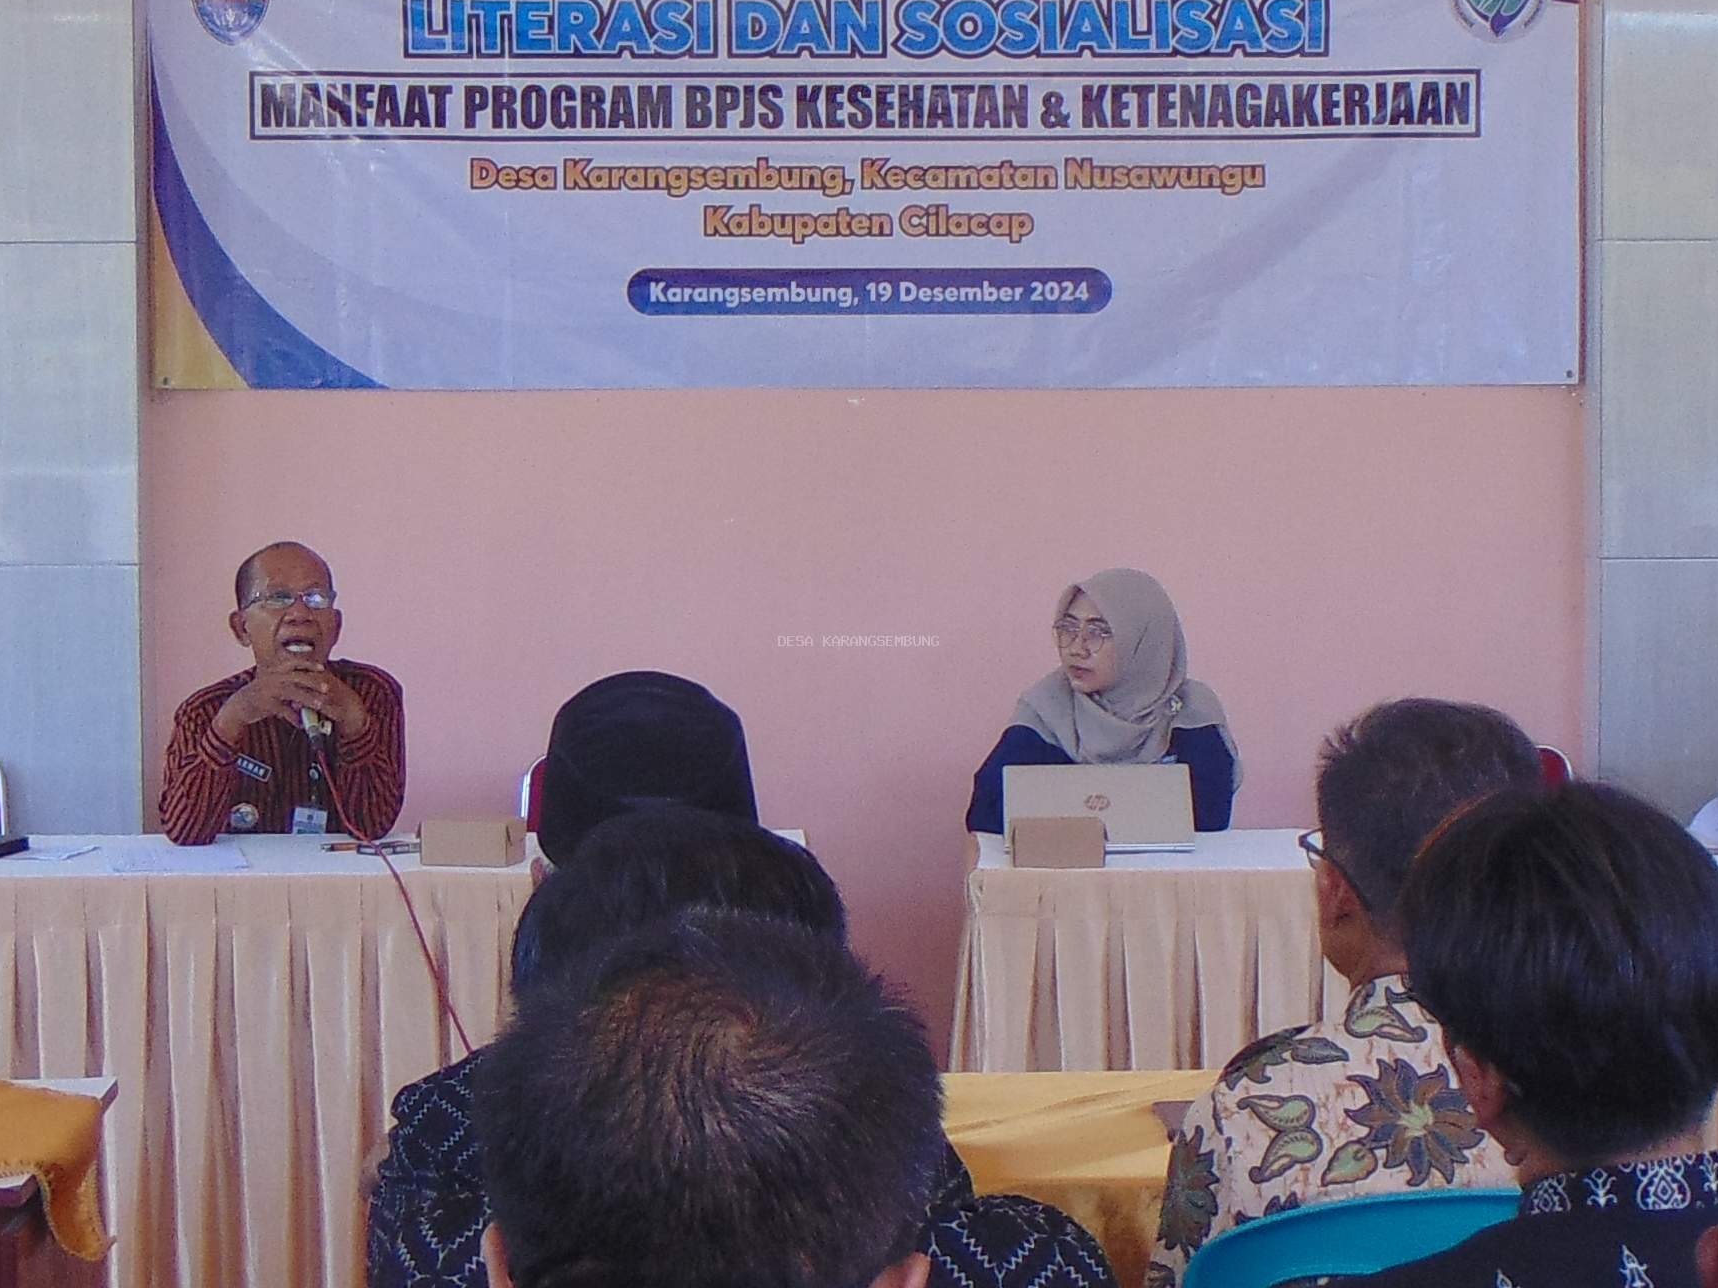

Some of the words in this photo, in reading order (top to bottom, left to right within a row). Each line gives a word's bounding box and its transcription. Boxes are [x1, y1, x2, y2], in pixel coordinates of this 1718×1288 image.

[259, 83, 453, 129] MANFAAT
[464, 83, 673, 129] PROGRAM
[685, 83, 784, 129] BPJS
[795, 83, 1029, 129] KESEHATAN
[1041, 89, 1071, 129] &
[1082, 81, 1471, 129] KETENAGAKERJAAN
[470, 157, 558, 189] Desa
[563, 157, 855, 198] Karangsembung,
[860, 157, 1058, 190] Kecamatan
[1064, 157, 1266, 196] Nusawungu
[703, 204, 893, 244] Kabupaten
[899, 204, 1035, 244] Cilacap
[649, 281, 859, 308] Karangsembung,
[866, 282, 893, 302] 19
[899, 280, 1024, 303] Desember
[1029, 281, 1090, 302] 2024
